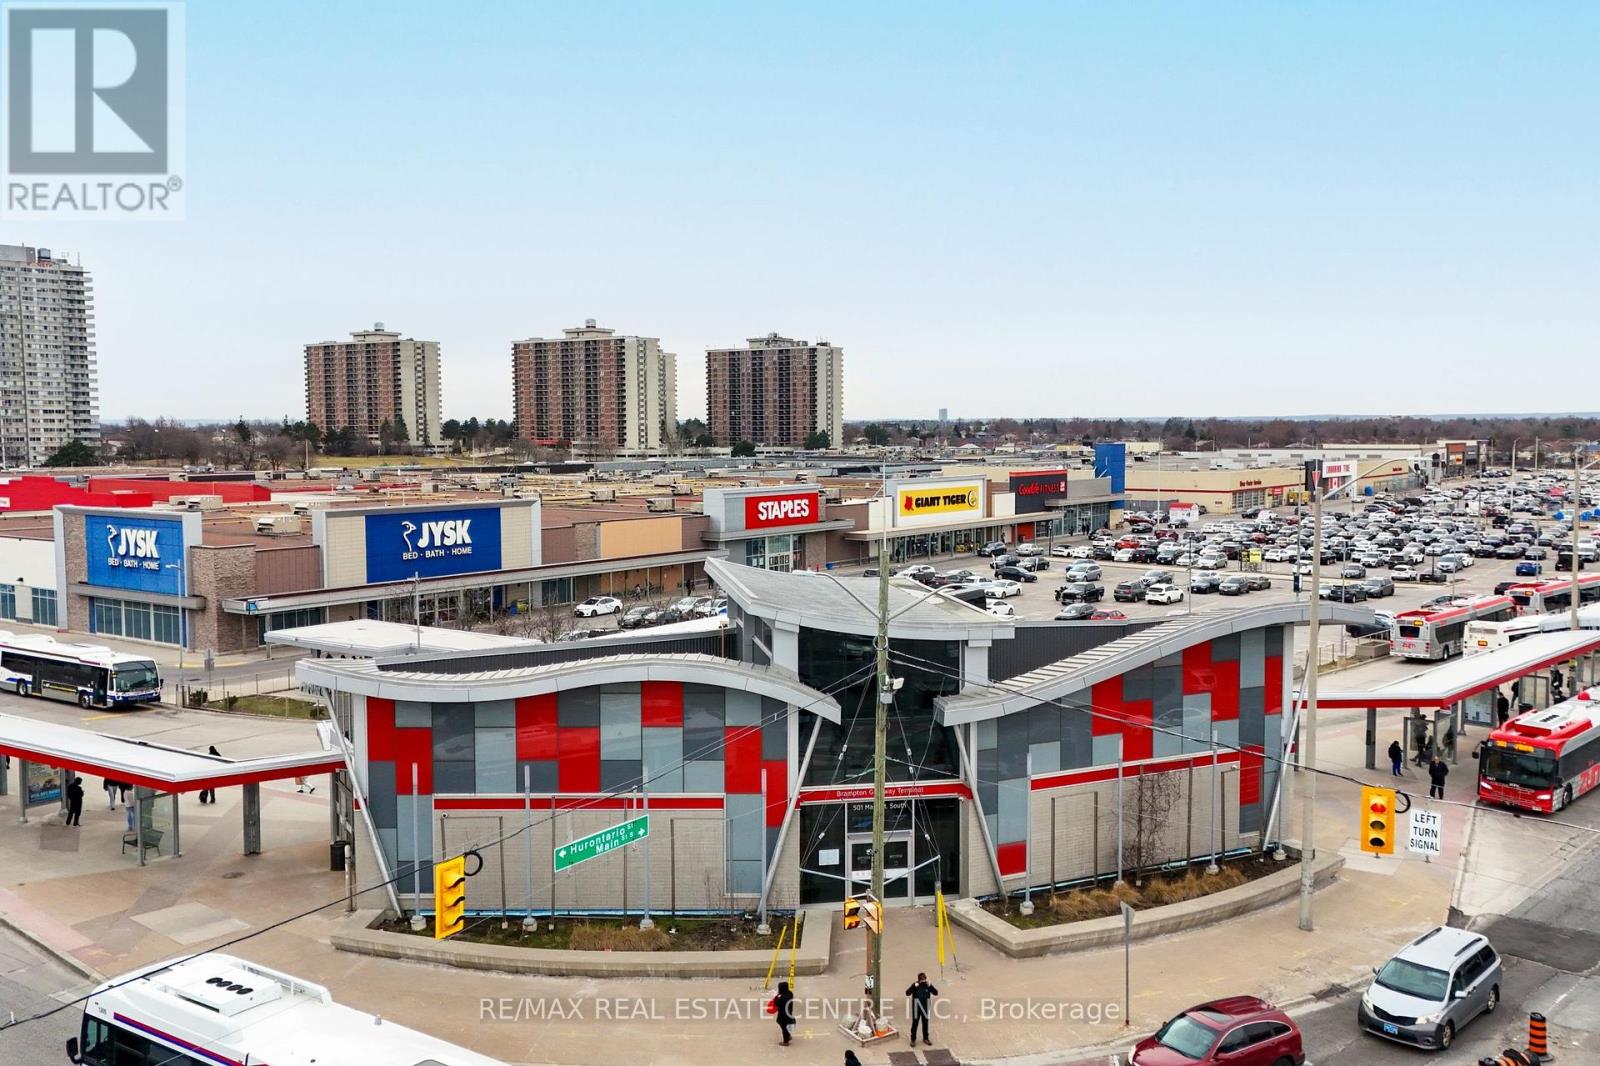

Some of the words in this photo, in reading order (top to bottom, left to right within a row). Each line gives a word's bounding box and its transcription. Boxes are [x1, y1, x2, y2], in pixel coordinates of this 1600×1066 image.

[915, 496, 941, 508] GIANT
[942, 494, 967, 506] TIGER
[758, 499, 810, 521] STAPLES
[417, 519, 473, 549] JYSK
[117, 528, 160, 558] JYSK
[402, 551, 419, 560] BED
[425, 549, 445, 558] BATH
[451, 546, 473, 556] HOME
[107, 557, 120, 566] BED
[123, 559, 139, 568] BATH
[142, 561, 160, 570] HOME
[836, 789, 868, 798] Brampton
[897, 786, 924, 794] Terminal
[1414, 813, 1437, 825] LEFT
[1413, 826, 1438, 839] TURN
[570, 828, 626, 855] Hurontario
[595, 839, 620, 854] Main
[1410, 838, 1440, 851] SIGNAL
